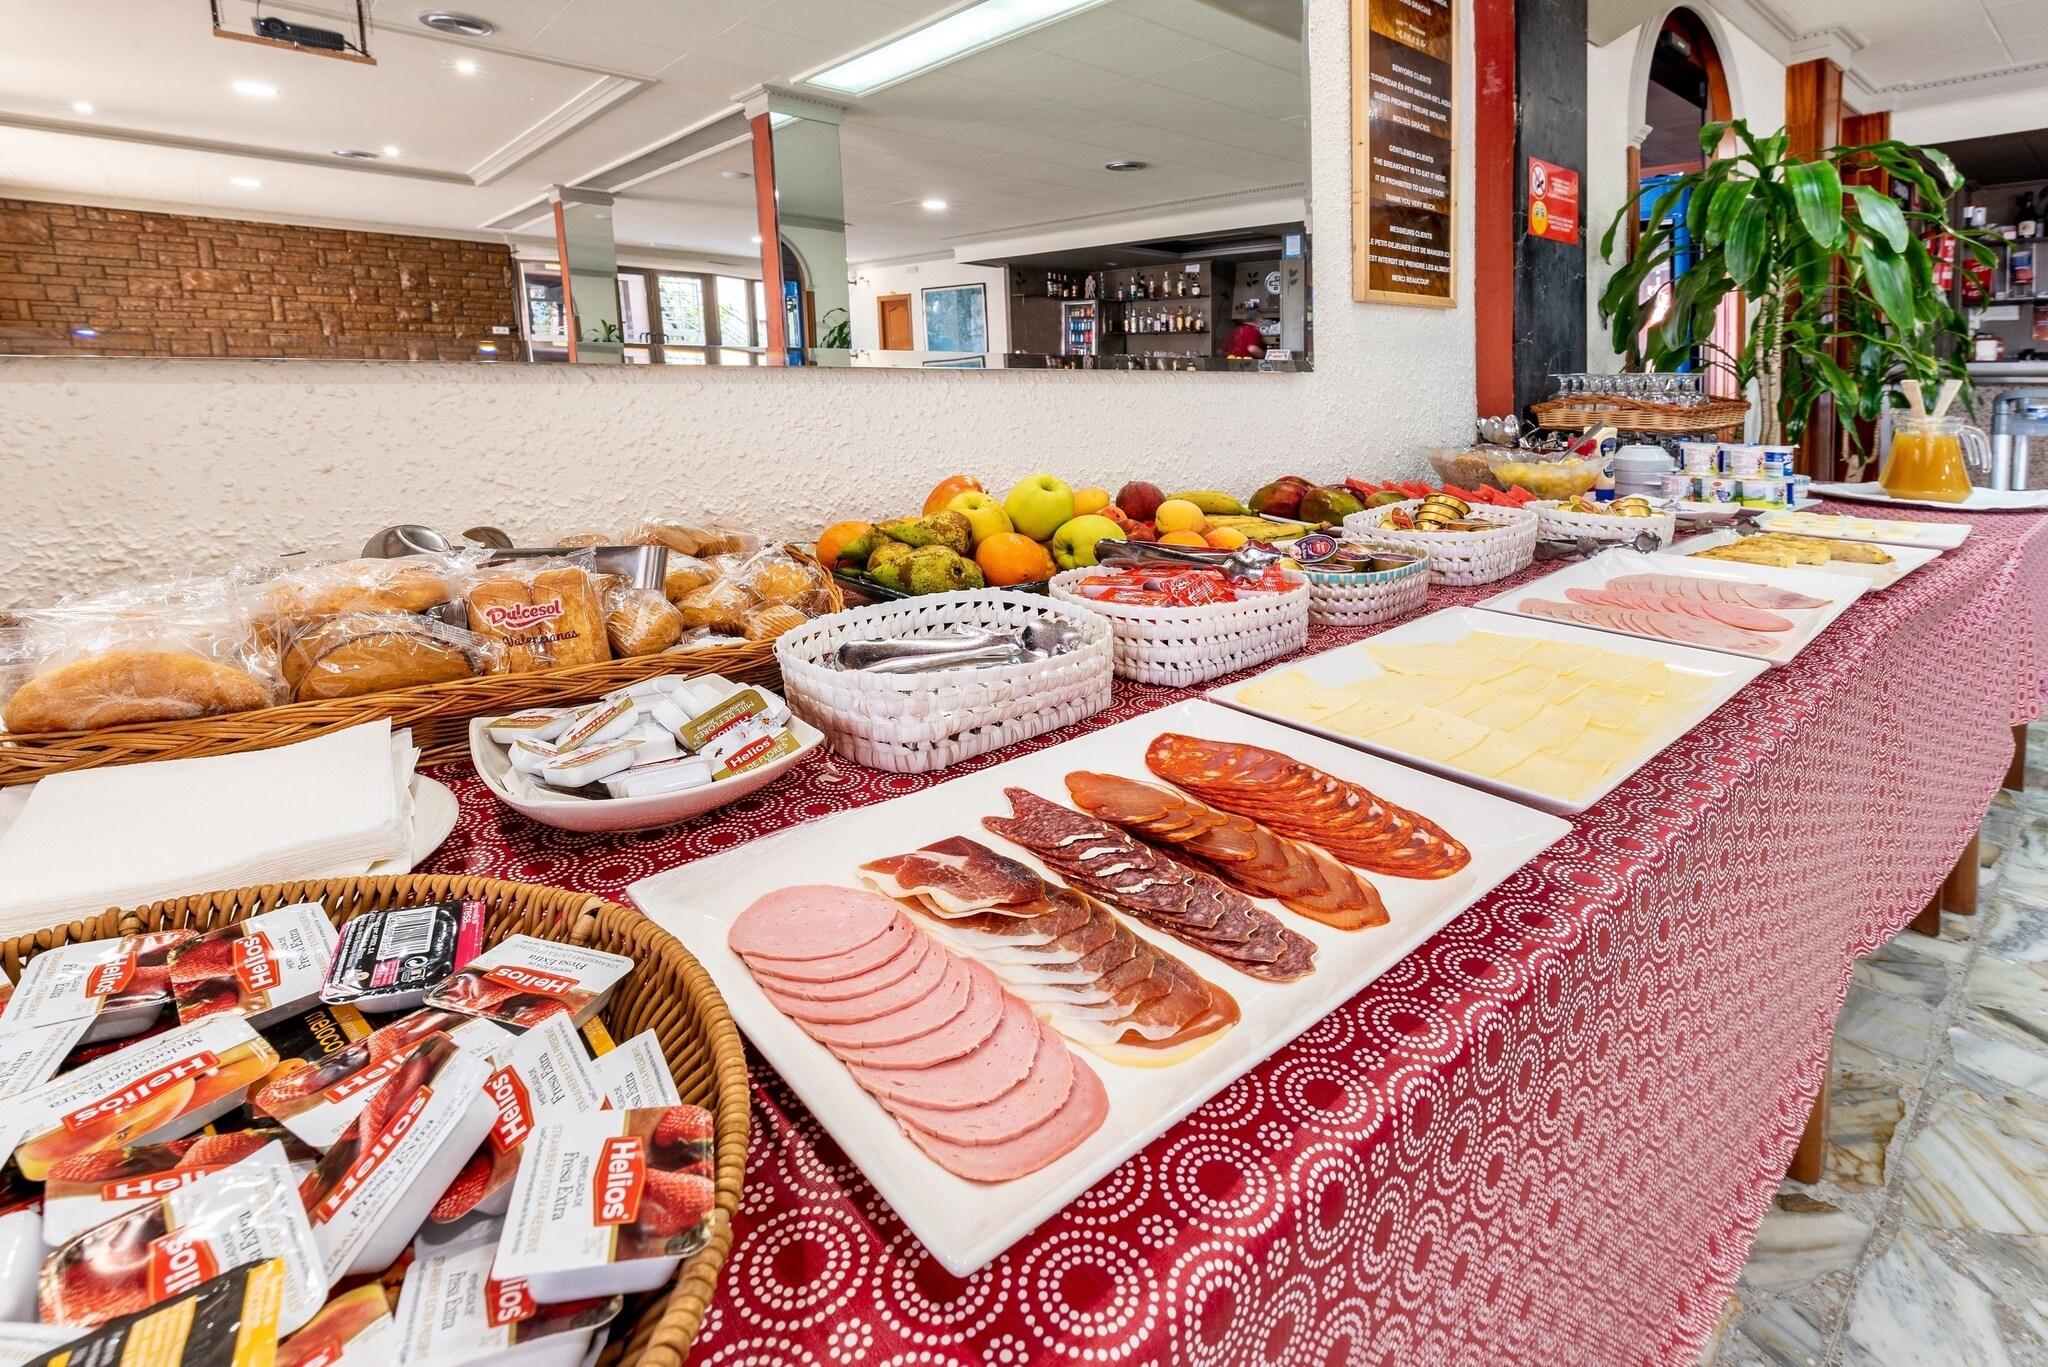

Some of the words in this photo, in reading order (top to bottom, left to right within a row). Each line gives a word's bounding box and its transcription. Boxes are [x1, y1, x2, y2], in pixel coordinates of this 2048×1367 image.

[1404, 85, 1414, 95] PER
[1413, 72, 1432, 85] CLIENTS
[1373, 91, 1391, 103] QUEDA
[1373, 156, 1384, 166] THE
[1383, 159, 1411, 173] BREAKFAST
[1410, 167, 1415, 175] IS
[1415, 168, 1422, 177] TO
[1421, 170, 1430, 179] EAT
[1388, 144, 1416, 159] GENTLEMEN
[1415, 152, 1434, 164] CLIENTS
[1374, 174, 1381, 183] IT
[1380, 175, 1386, 184] IS
[1385, 177, 1413, 190] PROHIBITED
[1412, 183, 1419, 192] TO
[1418, 185, 1433, 195] LEAVE
[1385, 193, 1402, 204] THANK
[1401, 197, 1411, 206] YOU
[1411, 200, 1423, 208] VERY
[1414, 230, 1433, 240] CLIENTS
[1377, 255, 1399, 266] INTERDIT
[1398, 259, 1405, 267] DE
[1405, 260, 1425, 270] PRENDRE
[1425, 263, 1434, 271] LES
[1411, 245, 1420, 253] EST
[1419, 246, 1427, 254] DE
[1426, 248, 1445, 257] MANGER
[486, 600, 562, 625] Dulcesol
[502, 630, 580, 648] Valencianas
[728, 713, 736, 721] DE
[736, 701, 754, 713] MIEL
[693, 720, 723, 741] FLORES
[730, 739, 772, 768] Helios
[748, 761, 760, 770] DE
[760, 742, 788, 762] FLORES
[289, 928, 304, 949] Extra
[243, 936, 274, 989] Helios
[496, 968, 570, 993] Helios
[304, 1010, 345, 1053] meloco
[334, 1046, 419, 1096] Heli
[538, 1053, 555, 1080] Extra
[49, 1081, 103, 1109] Extra
[74, 1057, 207, 1124] Helios
[547, 1074, 565, 1105] Fresa
[624, 1072, 638, 1096] Extra
[492, 1073, 527, 1145] Helios
[327, 1096, 426, 1210] Helios
[559, 1152, 580, 1183] Fresa
[602, 1141, 637, 1220] Helios
[116, 1170, 210, 1198] Heli
[551, 1185, 574, 1221] Extra
[238, 1210, 260, 1251] Extra
[158, 1237, 201, 1294] lios
[497, 1278, 528, 1322] lios
[441, 1297, 463, 1331] Extra
